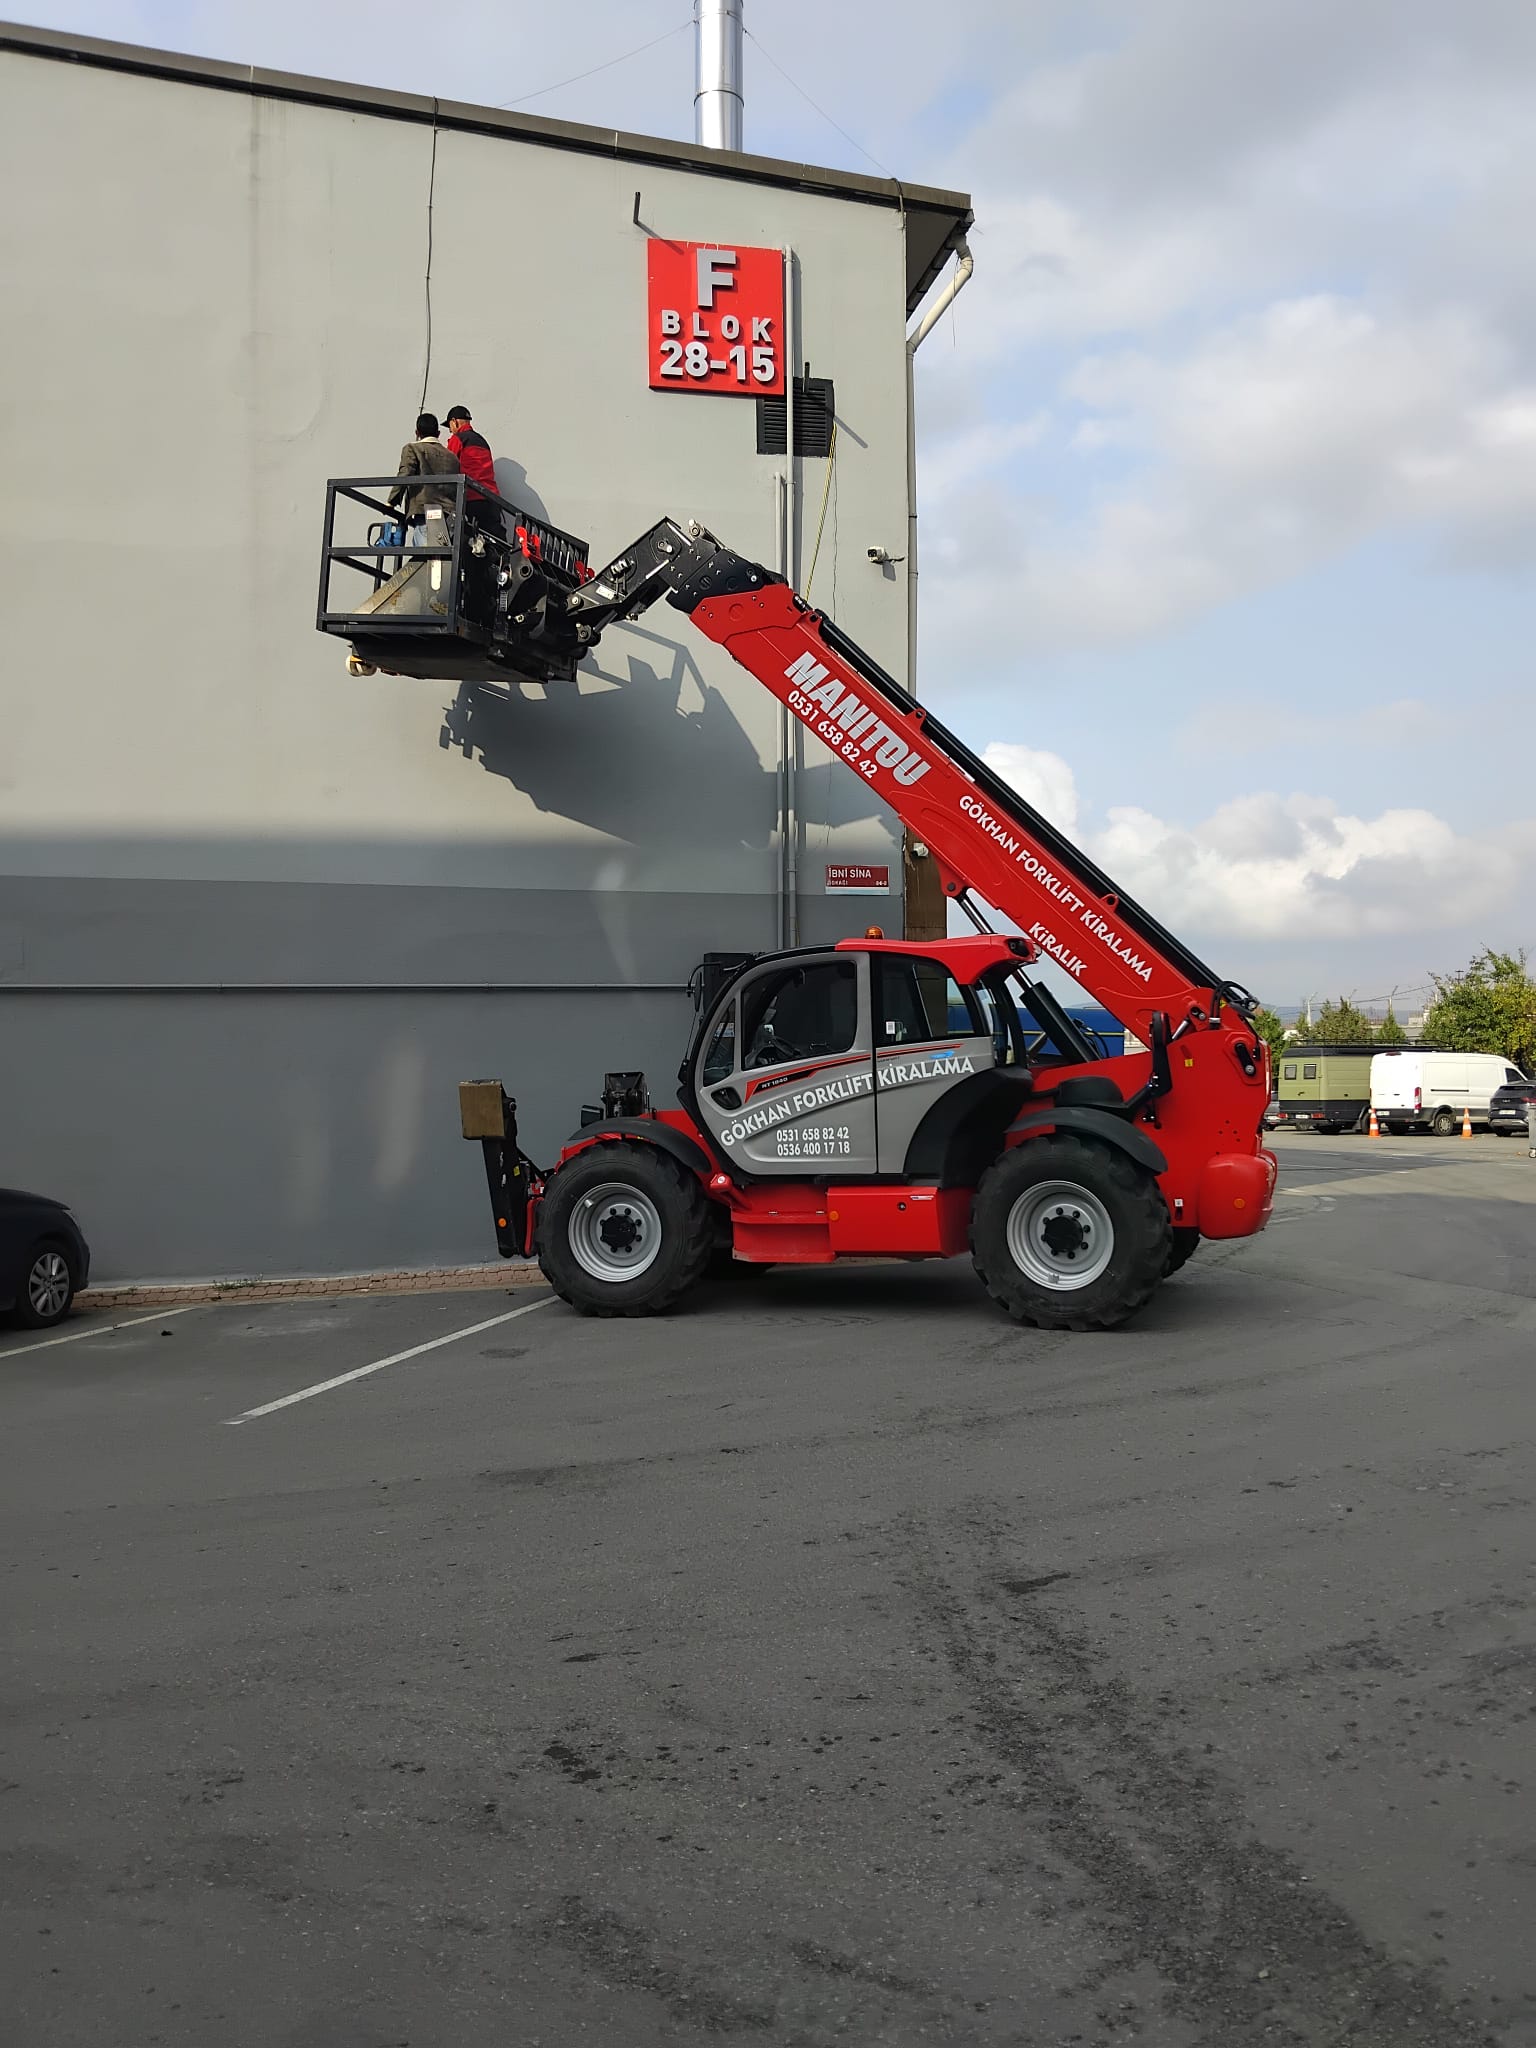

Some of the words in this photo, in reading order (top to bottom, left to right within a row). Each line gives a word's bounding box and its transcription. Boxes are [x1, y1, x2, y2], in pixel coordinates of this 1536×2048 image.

[697, 248, 736, 307] F
[661, 309, 772, 343] BLOK
[660, 339, 775, 382] 28-15
[784, 651, 932, 786] MANITOU
[788, 690, 819, 722] 0531
[817, 720, 844, 746] 658
[841, 741, 861, 763] 82
[858, 759, 878, 779] 42
[849, 867, 872, 879] SİNA
[959, 795, 1020, 855] GÖKHAN
[1016, 849, 1085, 913] FORKLİFT
[1079, 909, 1154, 983] KİRALAMA
[720, 1100, 792, 1147] GÖKHAN
[793, 1071, 873, 1112] FORKLİFT
[878, 1056, 975, 1088] KİRALAMA
[776, 1129, 799, 1142] 0531
[802, 1128, 820, 1141] 658
[822, 1127, 835, 1140] 82
[836, 1126, 850, 1139] 42
[777, 1143, 800, 1156] 0536
[802, 1142, 821, 1155] 400
[823, 1142, 835, 1154] 17
[838, 1141, 851, 1154] 18
